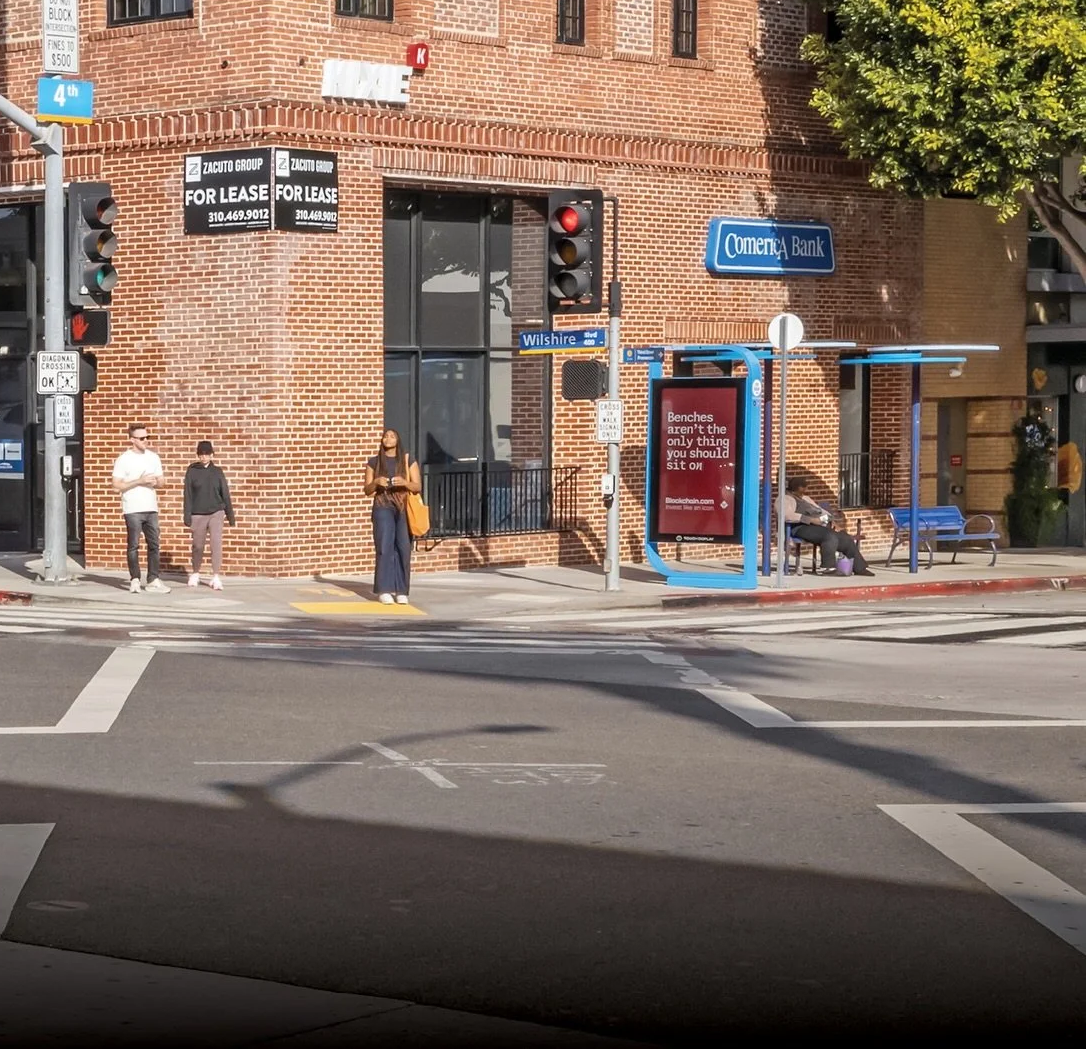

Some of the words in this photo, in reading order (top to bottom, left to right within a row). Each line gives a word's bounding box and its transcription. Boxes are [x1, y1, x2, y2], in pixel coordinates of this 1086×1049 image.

[48, 7, 73, 22] BLOCK
[45, 22, 77, 33] INTERSECTION
[47, 39, 65, 51] FINES
[67, 40, 74, 52] TO
[51, 53, 72, 67] $500
[416, 47, 426, 65] K
[53, 84, 79, 108] 4th
[203, 160, 233, 174] ZACUTO
[235, 158, 264, 172] GROUP
[291, 158, 315, 172] ZACUTO
[315, 159, 334, 174] GROUP
[185, 188, 217, 206] FOR
[220, 184, 269, 204] LEASE
[276, 184, 303, 202] FOR
[305, 186, 338, 204] LEASE
[208, 209, 269, 223] 310.469.9012
[295, 209, 337, 222] 310.469.9012
[791, 235, 825, 258] Bank
[522, 332, 577, 347] Wilshire
[583, 331, 598, 339] Blvd
[41, 362, 75, 370] CROSSING
[41, 376, 55, 388] OK
[599, 402, 620, 411] CROSS
[667, 411, 714, 423] Benches
[667, 423, 705, 435] aren't
[706, 423, 727, 435] the
[666, 435, 694, 449] only
[696, 435, 730, 449] thing
[666, 449, 687, 461] you
[689, 447, 730, 459] should
[666, 459, 686, 471] sit
